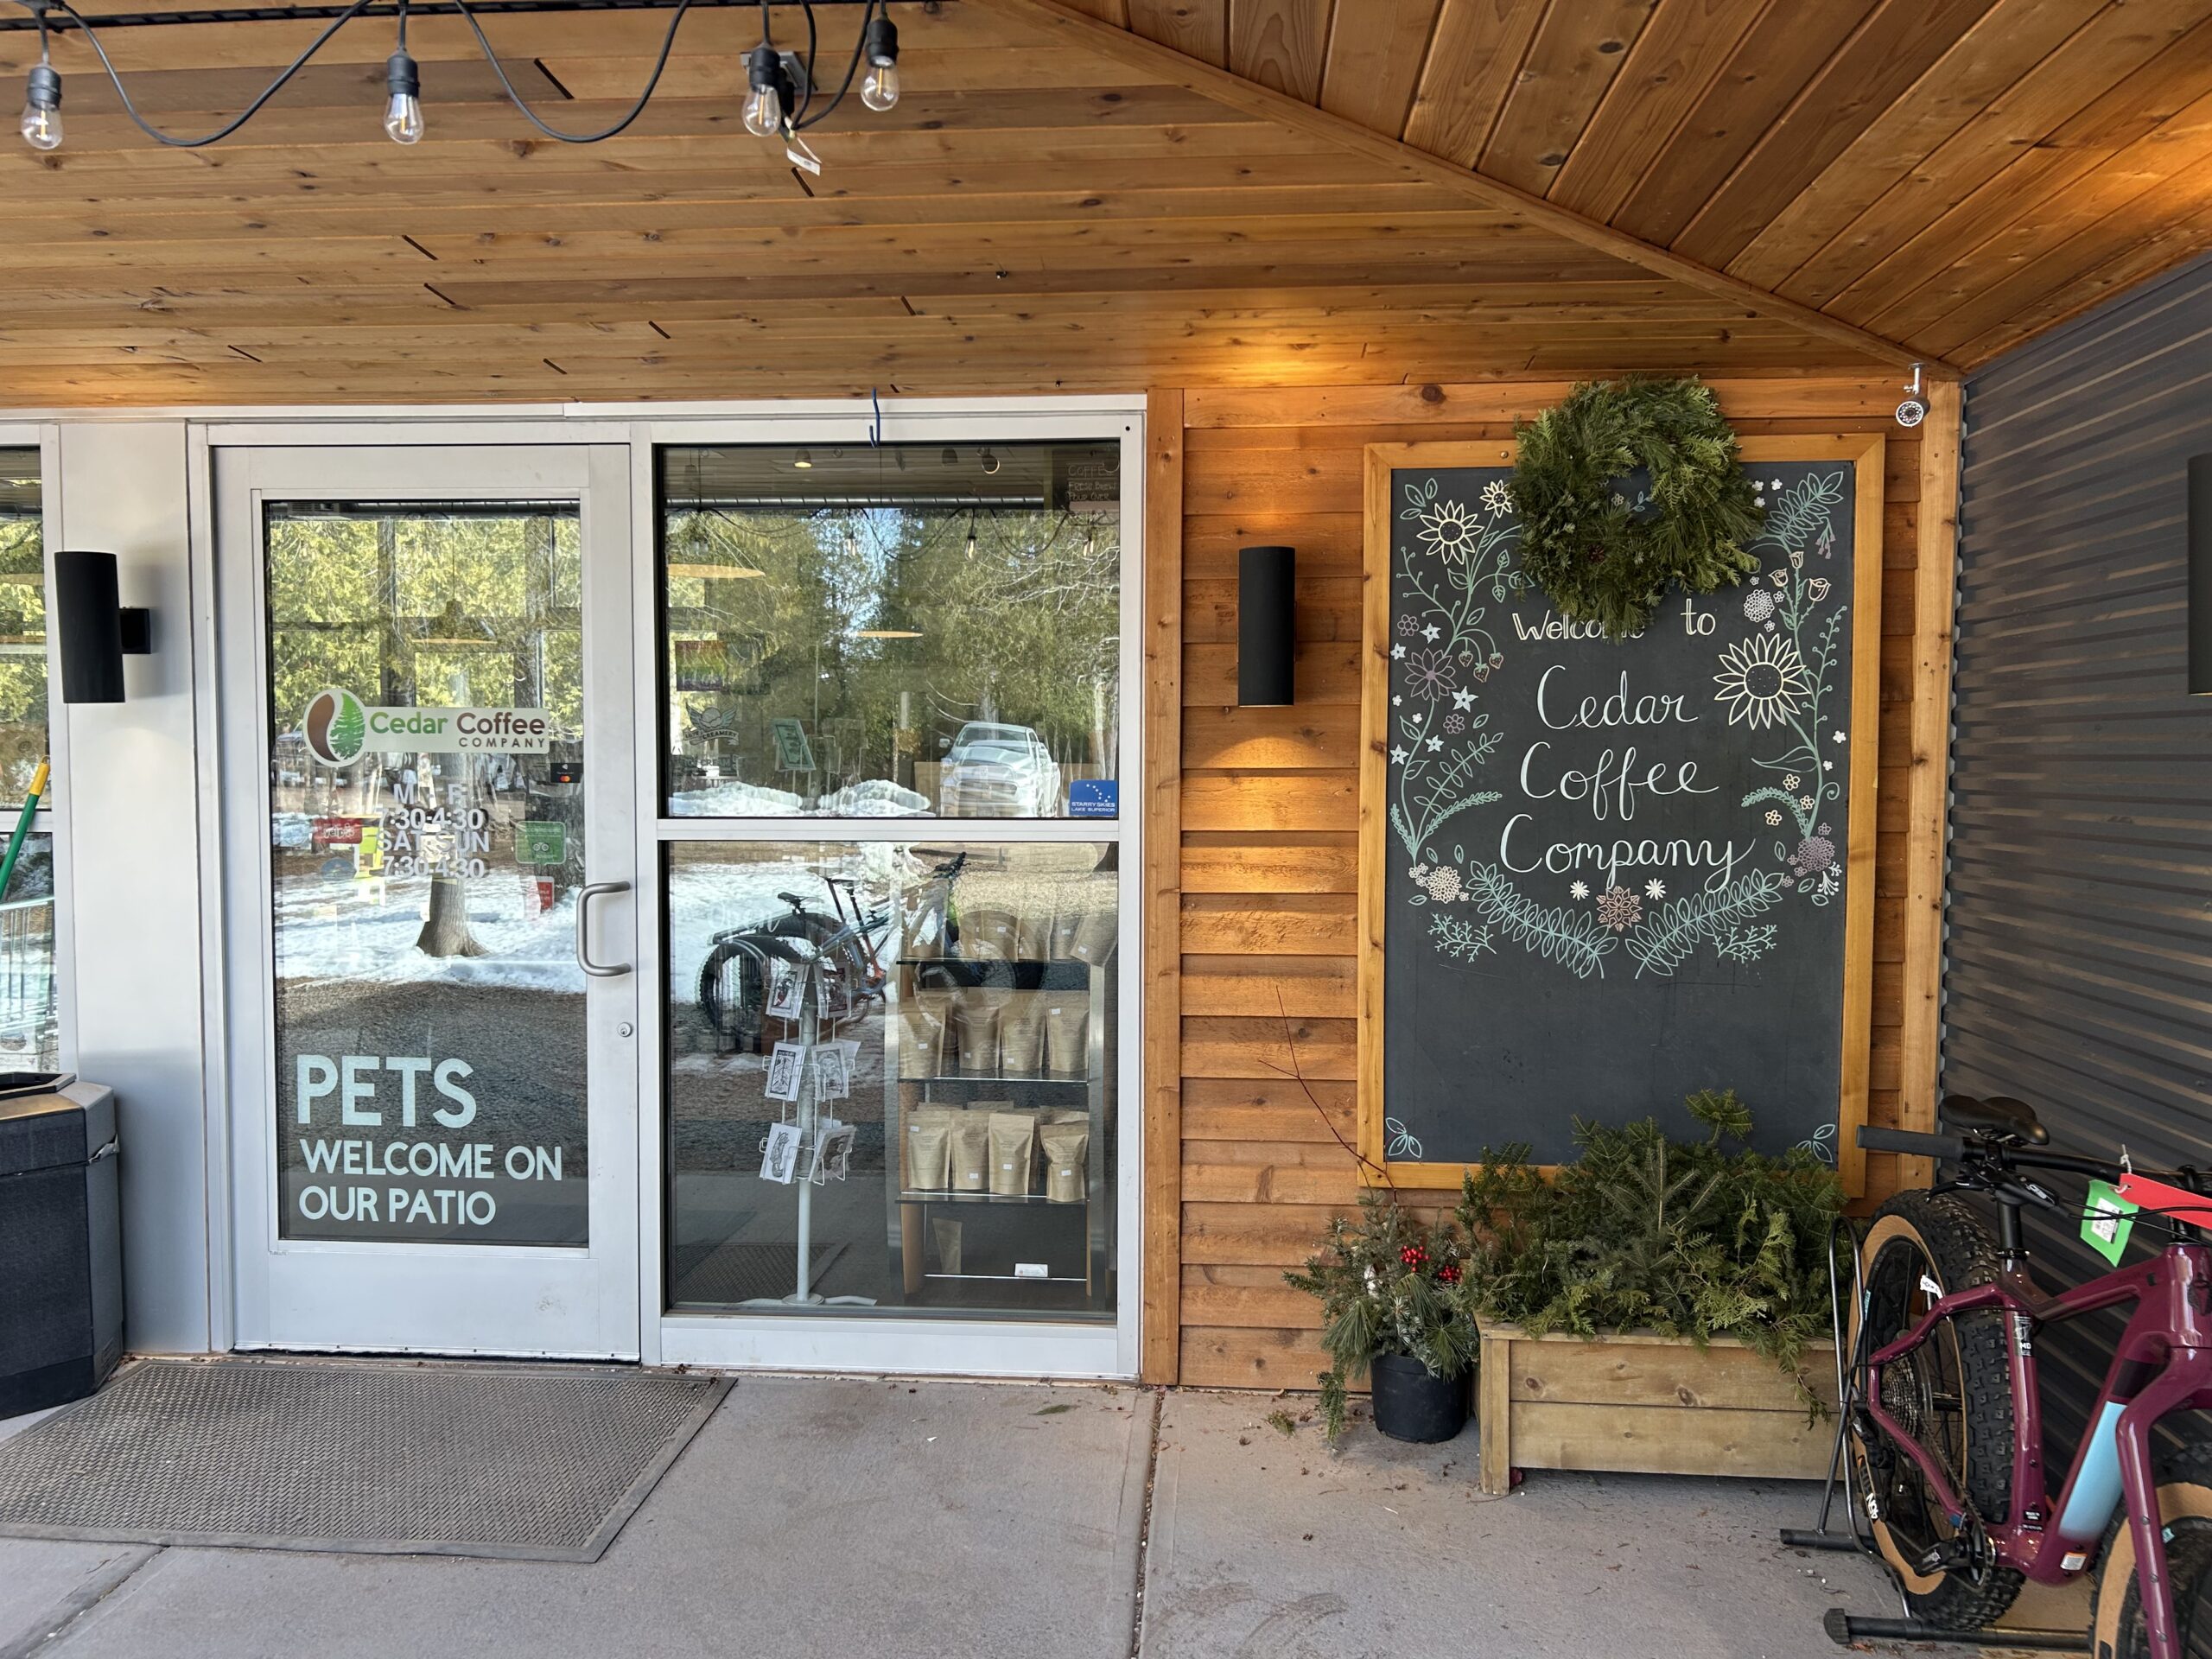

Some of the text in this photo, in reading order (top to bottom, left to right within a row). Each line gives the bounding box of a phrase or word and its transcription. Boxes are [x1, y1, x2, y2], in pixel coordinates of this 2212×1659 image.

[1680, 598, 1717, 637] to
[1536, 664, 1699, 730] Cedar
[369, 711, 546, 734] Cedar Coffee
[458, 736, 546, 748] COMPANY
[393, 783, 415, 804] M
[448, 783, 463, 804] F
[1520, 741, 1719, 821] Coffee
[1499, 813, 1757, 893] Company
[296, 1054, 477, 1128] PETS
[299, 1138, 562, 1181] WELCOME ON
[299, 1185, 497, 1225] OUR PATIO
